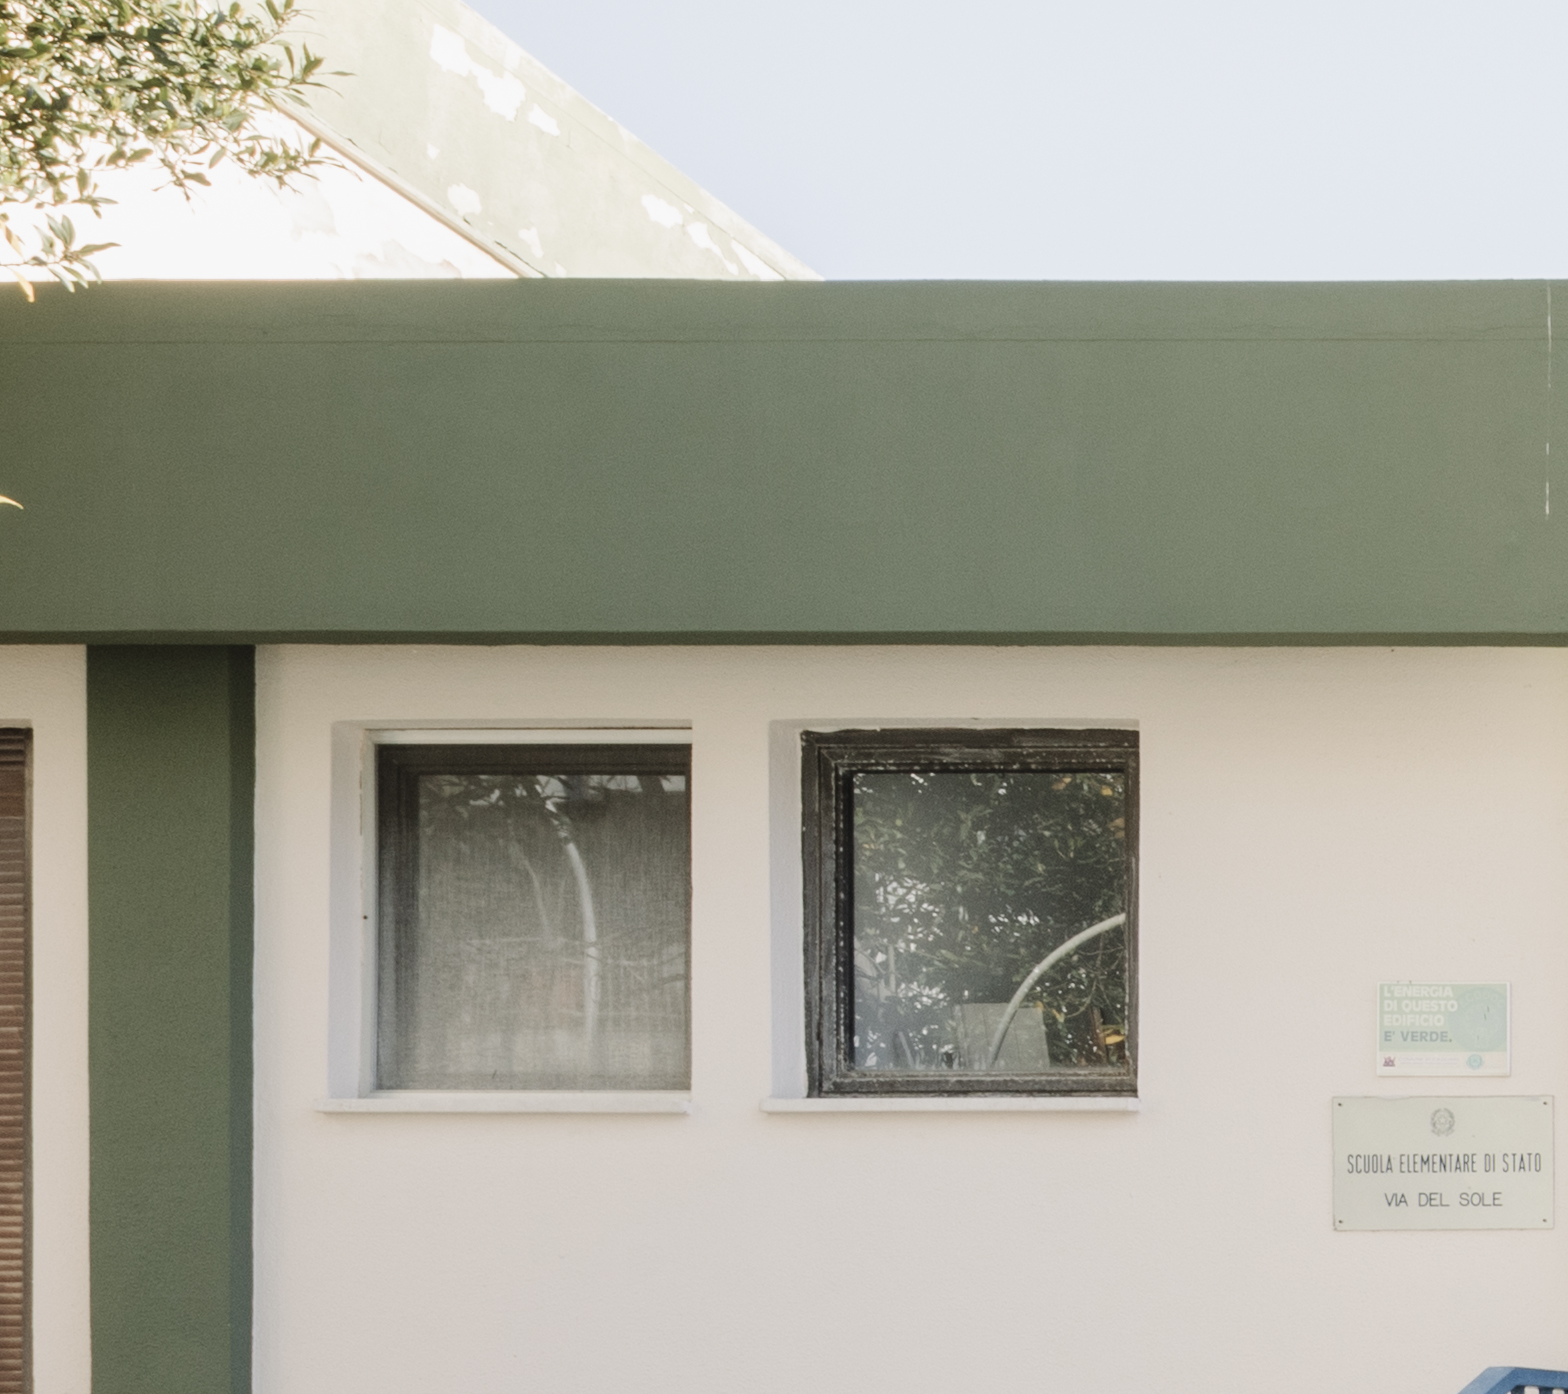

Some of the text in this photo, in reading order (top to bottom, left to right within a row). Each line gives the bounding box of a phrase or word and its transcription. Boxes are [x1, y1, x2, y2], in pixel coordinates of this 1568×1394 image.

[1383, 985, 1454, 998] L'ENERGIA
[1383, 999, 1458, 1013] DI QUESTO
[1383, 1014, 1445, 1027] EDIFICIO
[1383, 1030, 1453, 1043] E' VERDE.
[1347, 1152, 1542, 1174] SCUOLA ELEMENTARE DI STATO
[1384, 1191, 1503, 1207] VIA DEL SOLE
